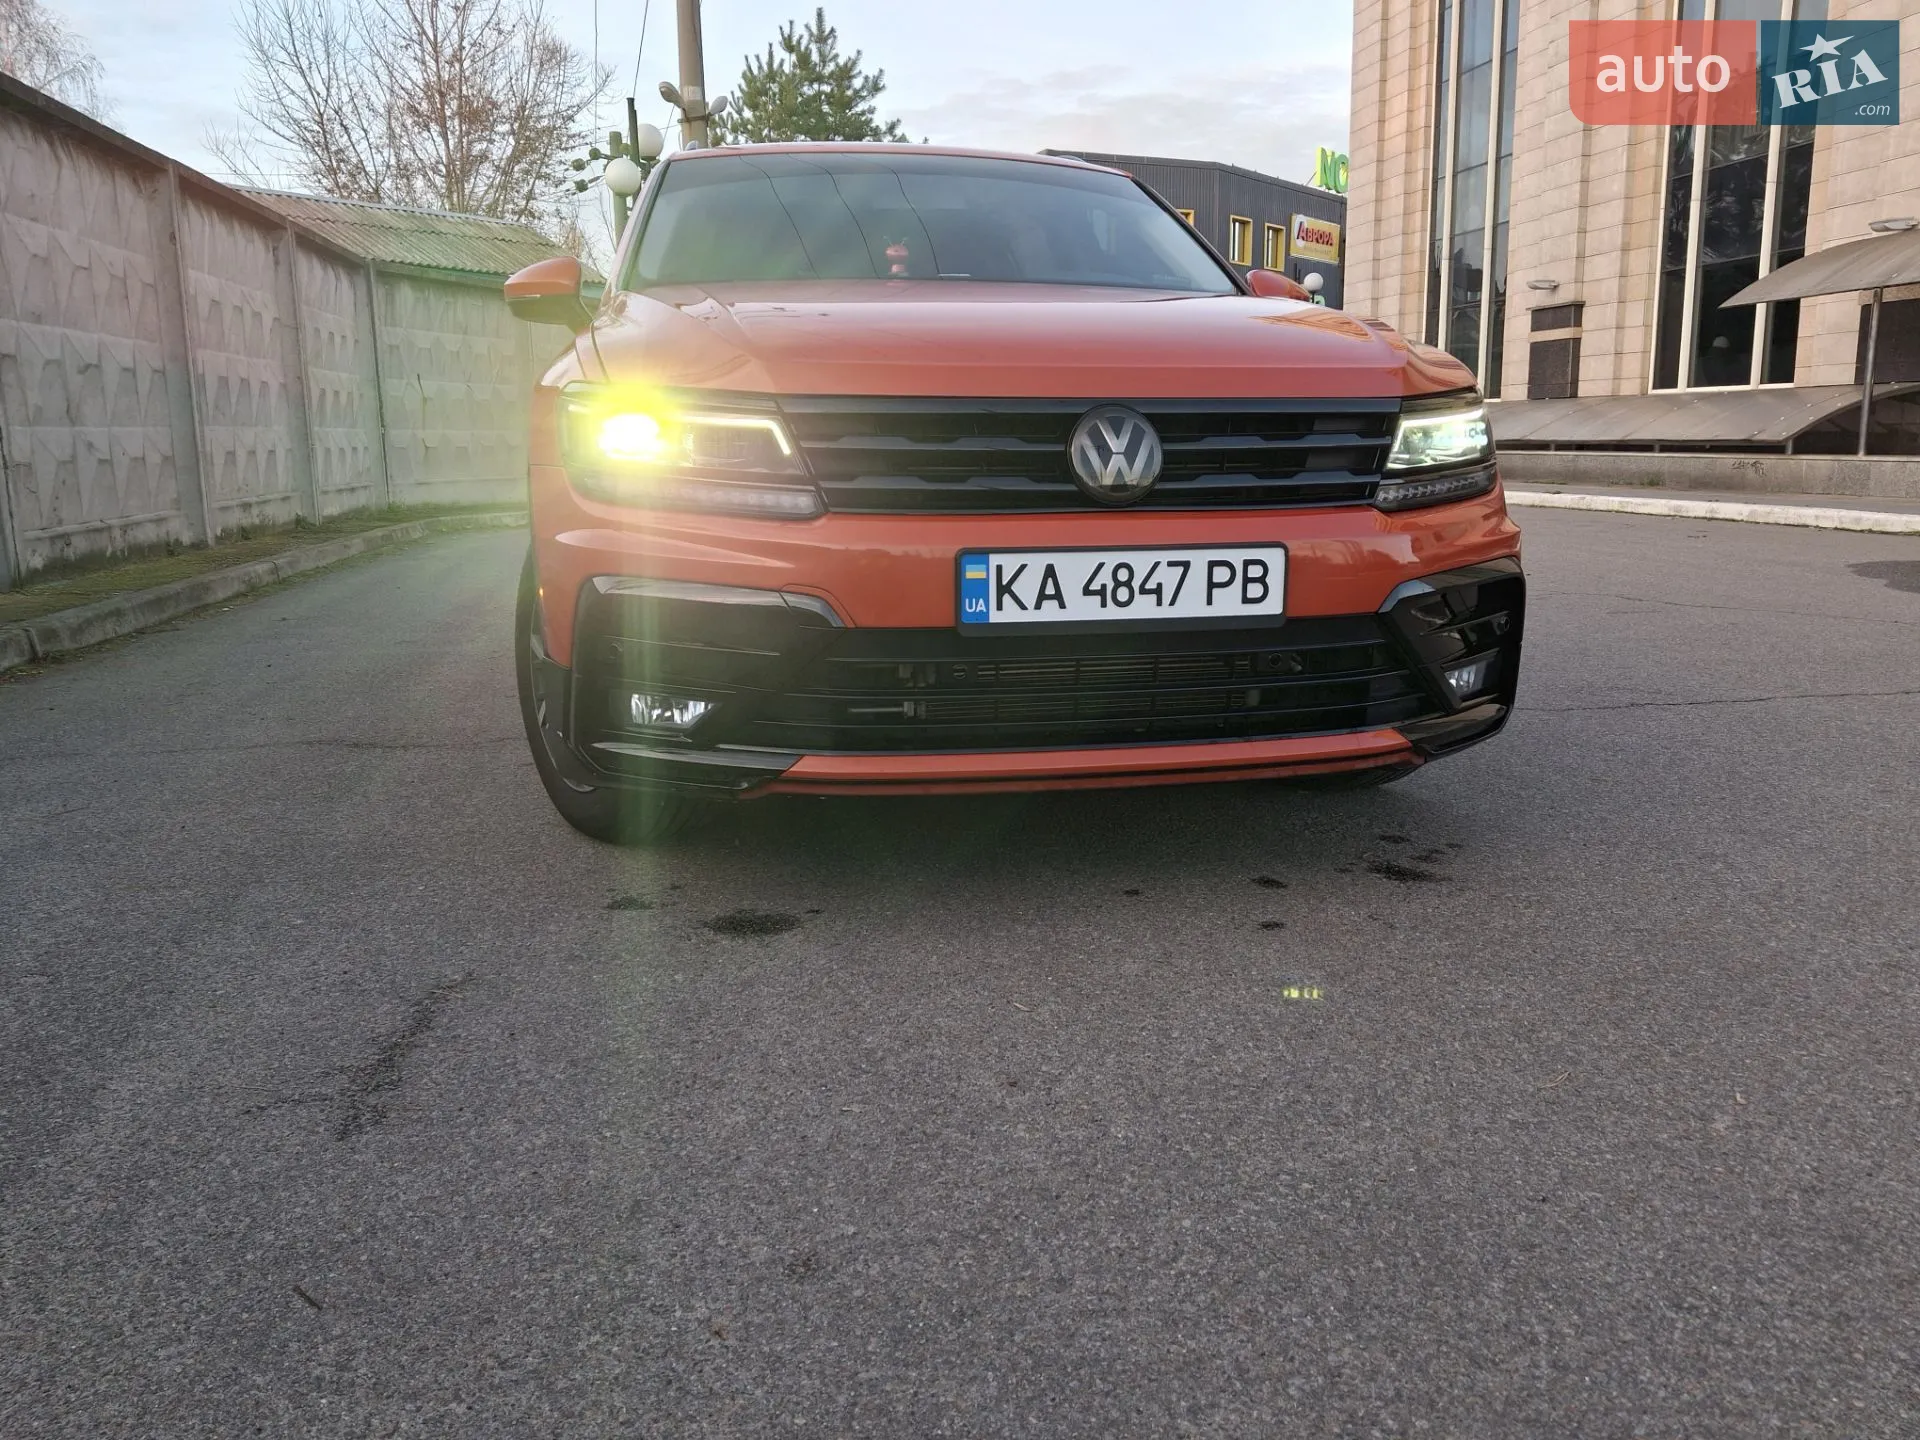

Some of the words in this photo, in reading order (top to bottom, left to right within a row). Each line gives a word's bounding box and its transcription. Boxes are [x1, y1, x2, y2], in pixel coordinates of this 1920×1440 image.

[995, 563, 1067, 611] KA
[1082, 560, 1192, 609] 4847
[1206, 558, 1270, 606] PB
[965, 598, 987, 613] UA
